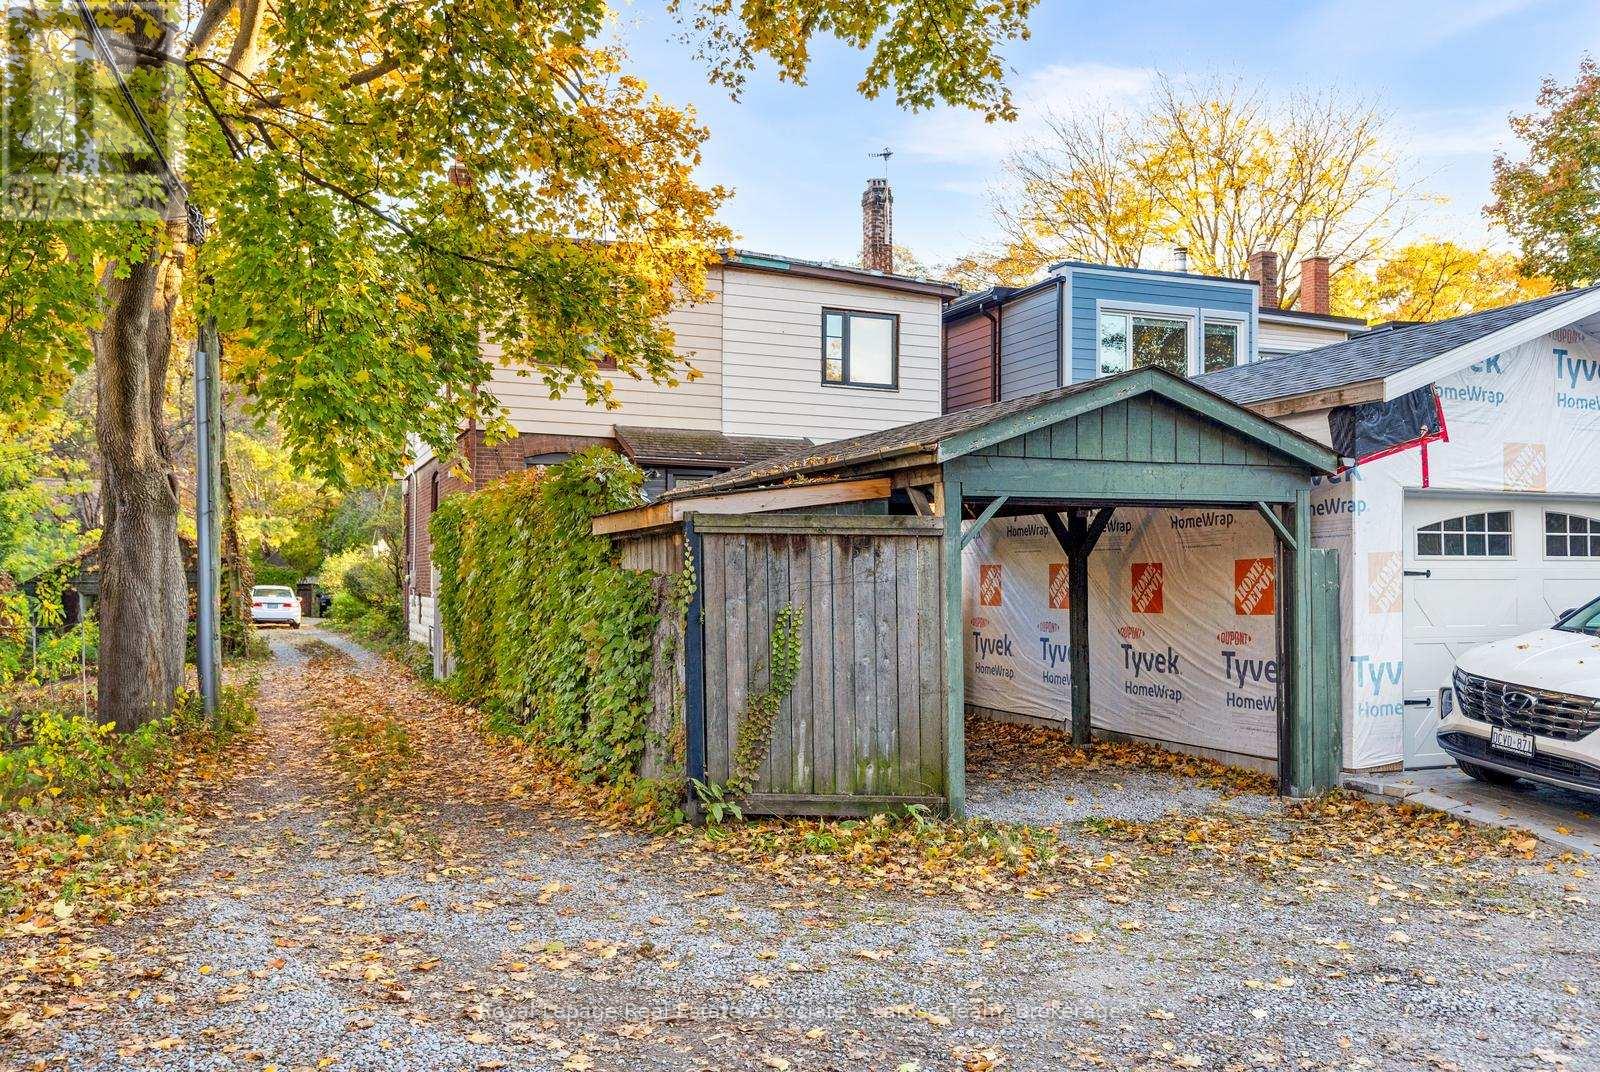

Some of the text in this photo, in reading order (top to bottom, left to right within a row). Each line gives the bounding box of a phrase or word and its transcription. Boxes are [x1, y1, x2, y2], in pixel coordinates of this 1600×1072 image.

[1552, 348, 1600, 389] Tyv
[1436, 384, 1505, 408] omeWrap
[1006, 524, 1049, 538] HomeWrap
[1170, 511, 1235, 530] HomeWrap
[1235, 558, 1265, 603] HOME
[1241, 565, 1275, 615] DEPOT
[973, 631, 1013, 660] Tyvek
[1039, 637, 1071, 668] Tyv
[975, 662, 1014, 681] HomeWrap
[1120, 643, 1180, 678] Tyvek
[1221, 650, 1278, 689] Tyve
[1350, 655, 1403, 696] Tyv
[1125, 680, 1182, 703] HomeWrap
[1226, 691, 1277, 711] HomeW
[1358, 702, 1403, 718] Home
